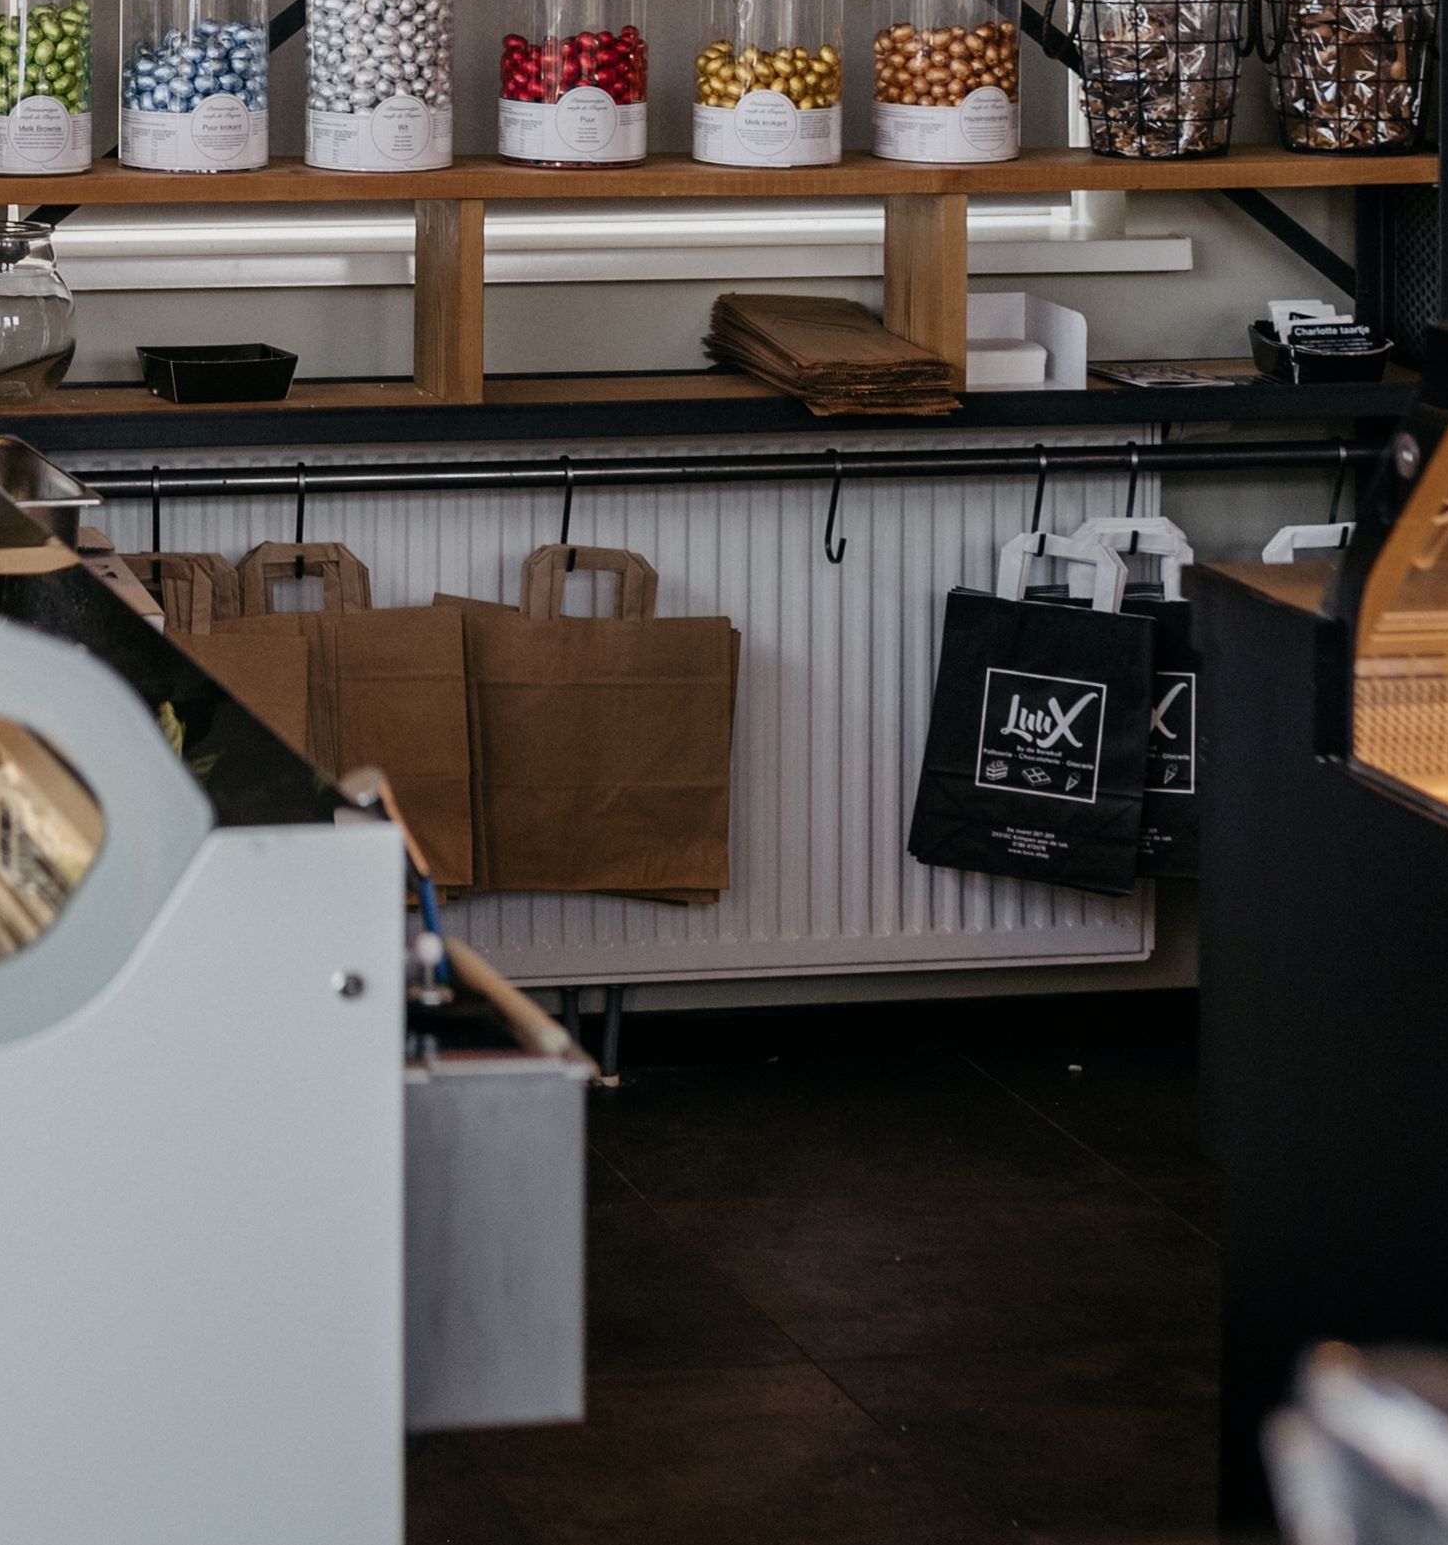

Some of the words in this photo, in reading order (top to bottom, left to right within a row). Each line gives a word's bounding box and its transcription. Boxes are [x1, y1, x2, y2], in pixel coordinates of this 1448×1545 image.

[579, 115, 596, 123] Puur
[1293, 326, 1339, 337] Charlotte
[1339, 325, 1371, 336] taartje
[999, 691, 1099, 749] LuuX
